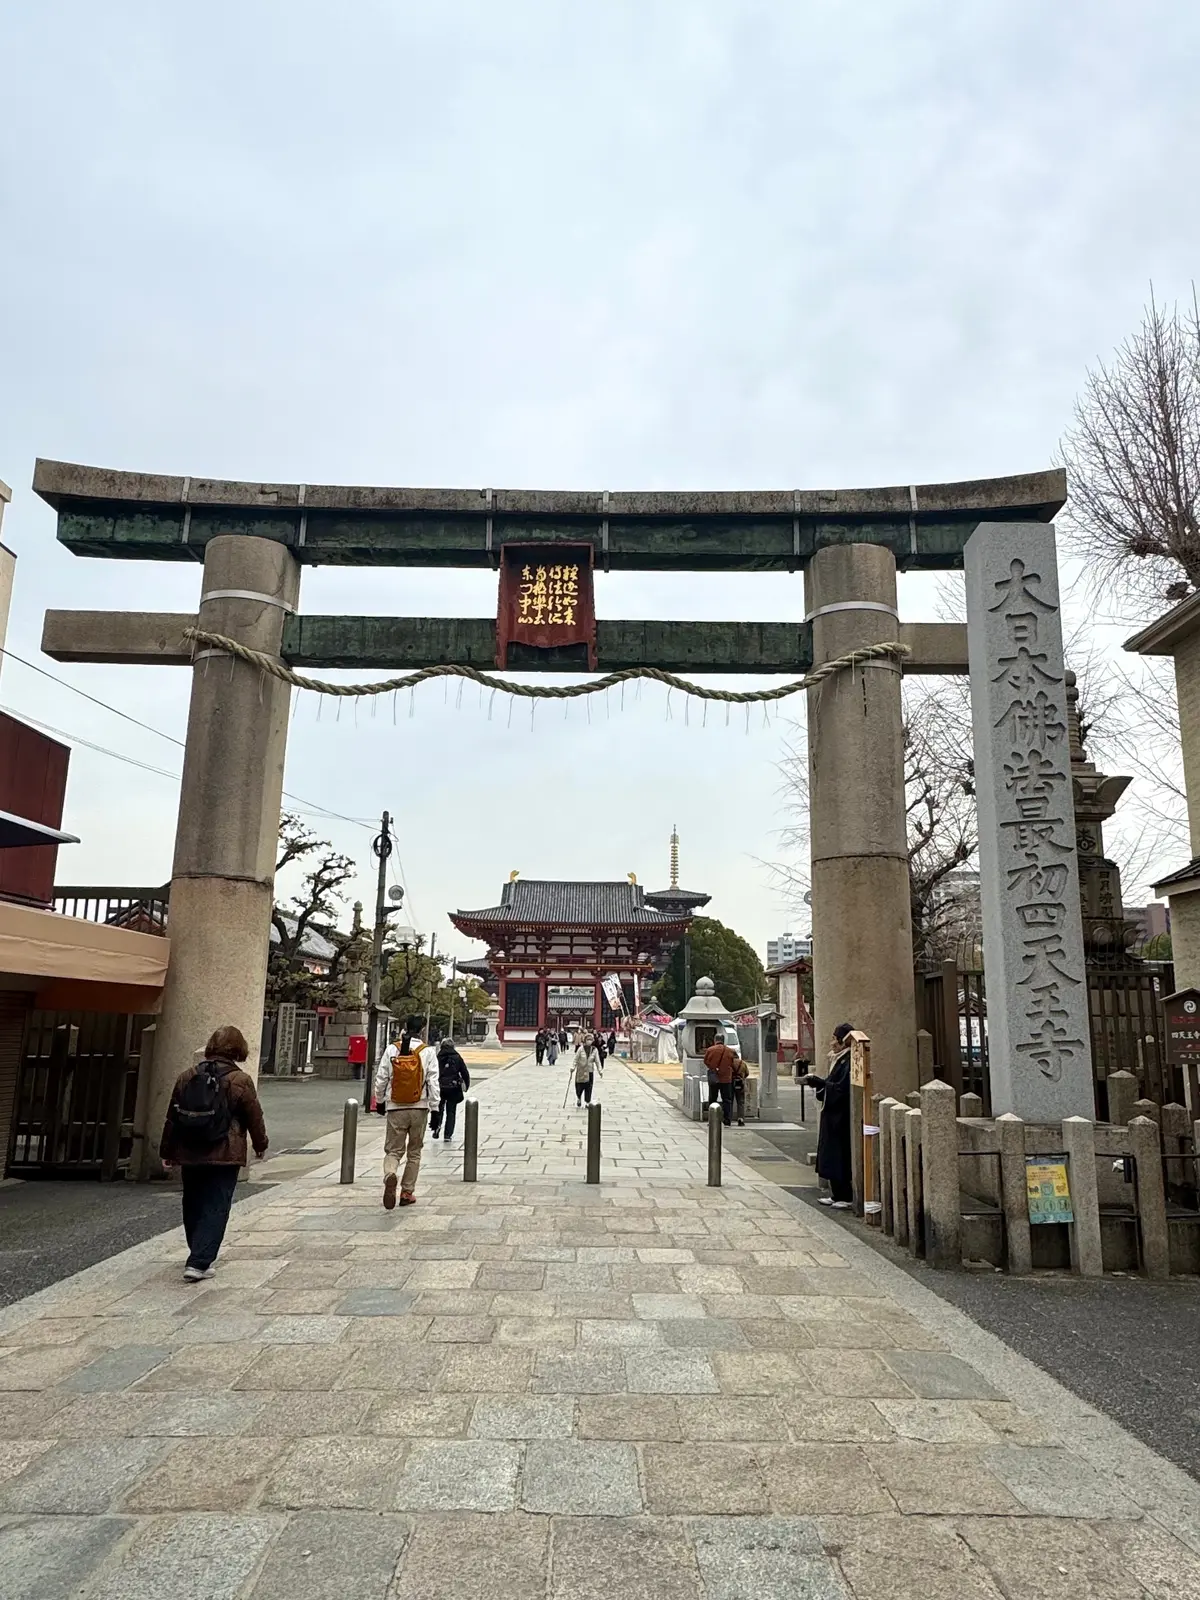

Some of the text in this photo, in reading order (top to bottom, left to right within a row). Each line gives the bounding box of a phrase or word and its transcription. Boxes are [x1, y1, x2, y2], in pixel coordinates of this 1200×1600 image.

[988, 557, 1085, 1083] 大日本佛法最初四天王寺
